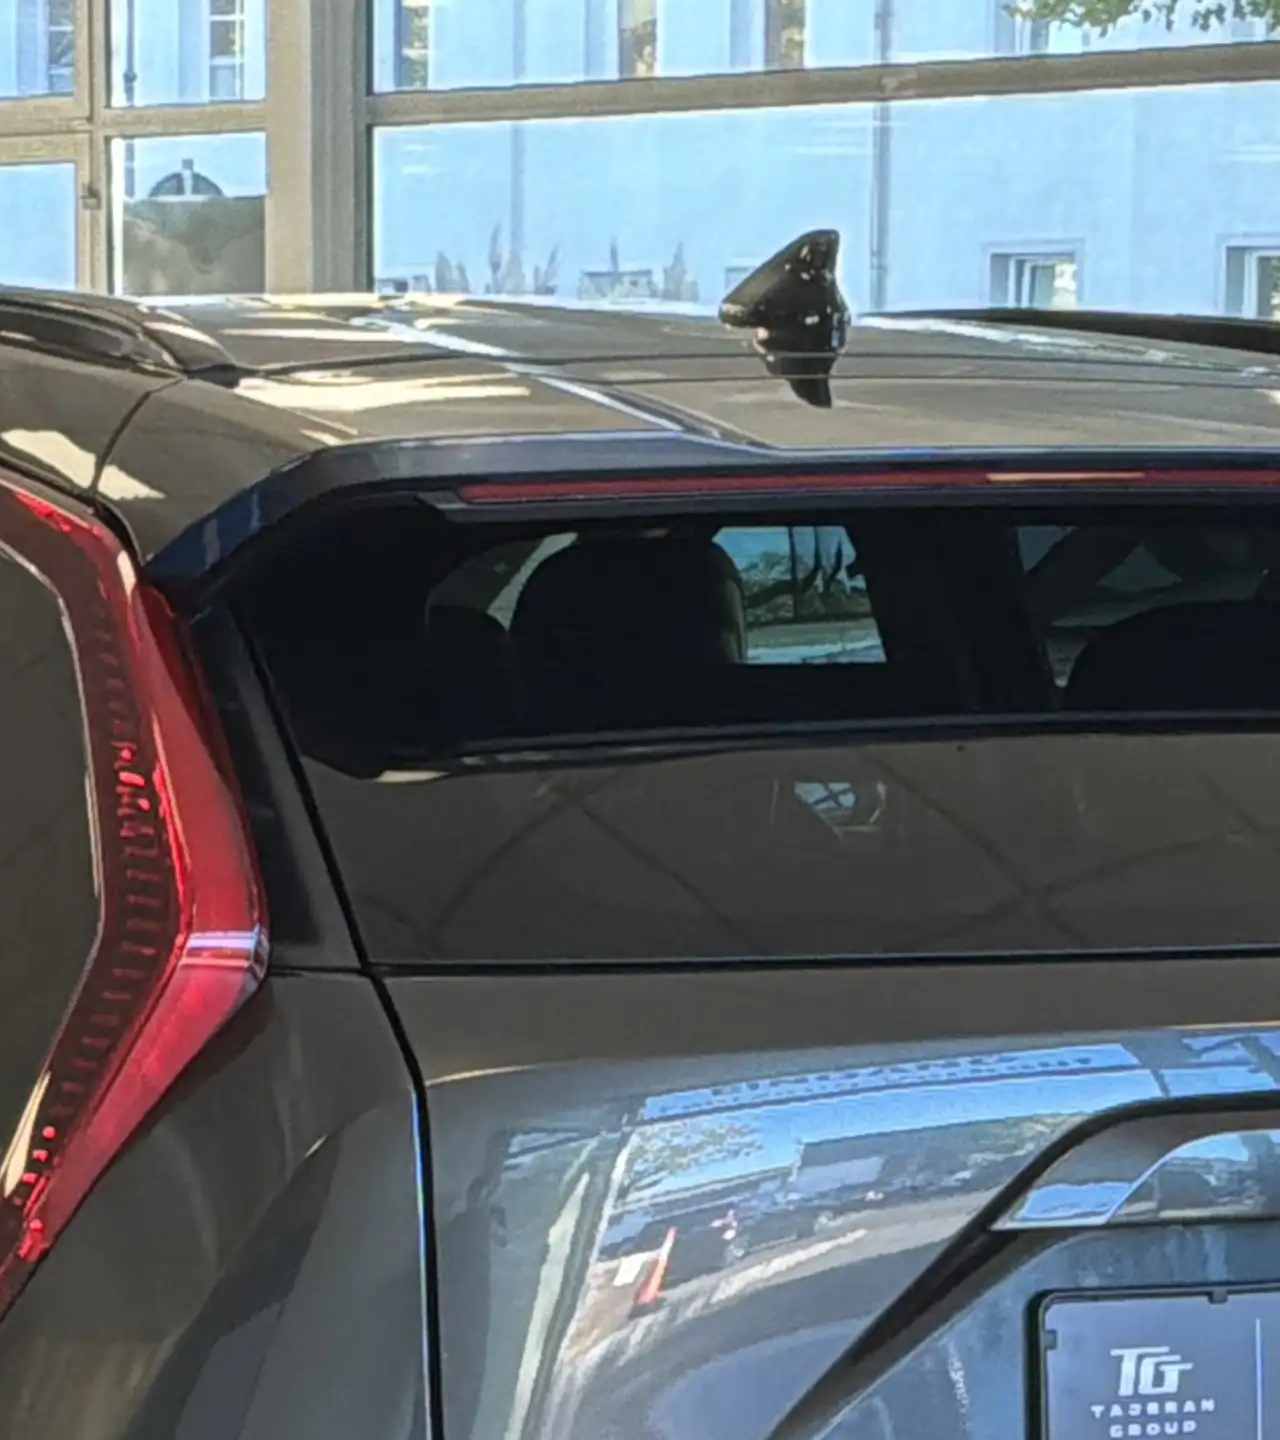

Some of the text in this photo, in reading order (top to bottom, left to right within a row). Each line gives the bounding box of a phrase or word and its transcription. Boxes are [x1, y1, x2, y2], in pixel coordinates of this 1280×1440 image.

[1110, 1346, 1194, 1396] TG
[1090, 1398, 1216, 1420] TAJERAN
[1110, 1420, 1197, 1439] GROUP
